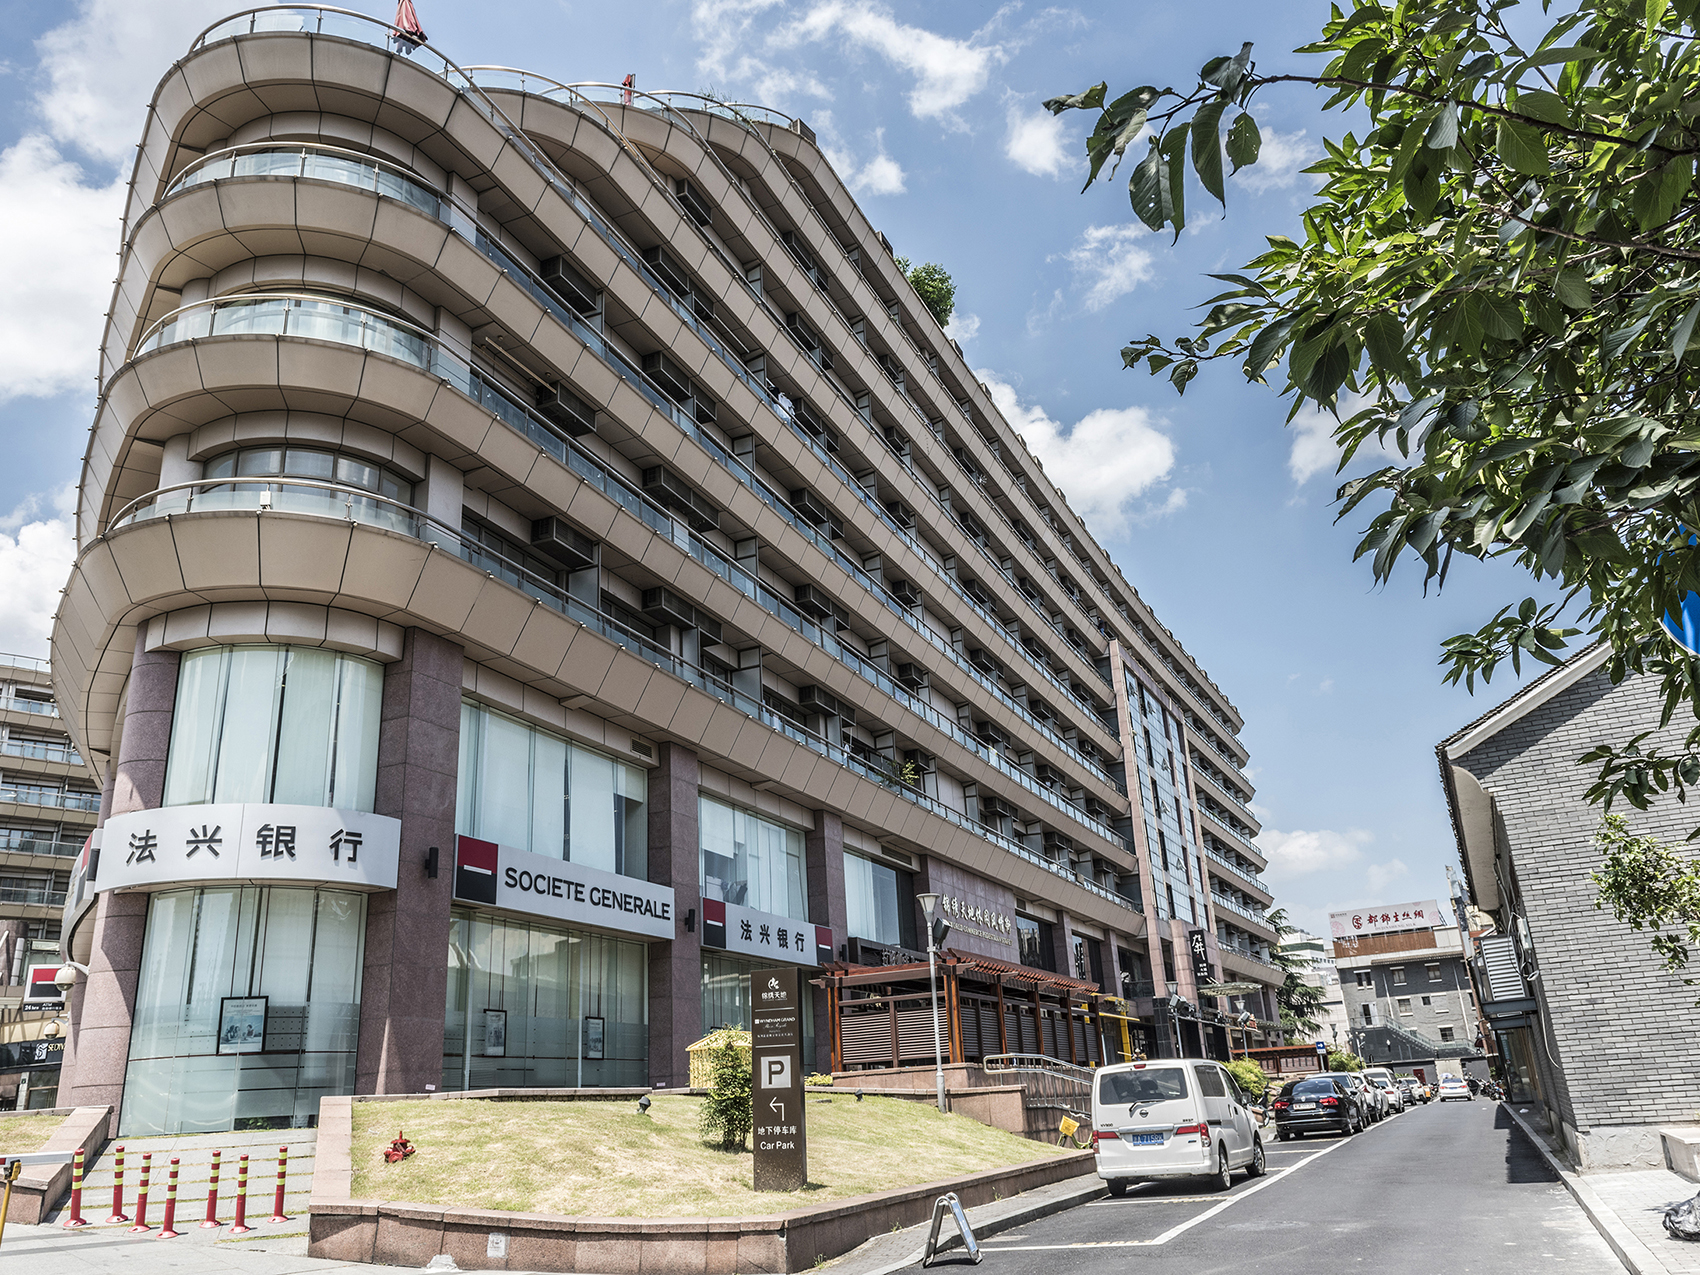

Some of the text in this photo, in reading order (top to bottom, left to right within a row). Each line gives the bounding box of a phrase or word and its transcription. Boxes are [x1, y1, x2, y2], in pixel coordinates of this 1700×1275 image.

[126, 823, 363, 865] 法兴银行
[504, 867, 671, 921] SOCIETE GENERALE
[740, 919, 805, 953] 法兴银行
[768, 1060, 785, 1085] P
[757, 1125, 797, 1135] 地下停车库
[760, 1140, 795, 1150] Car Park
